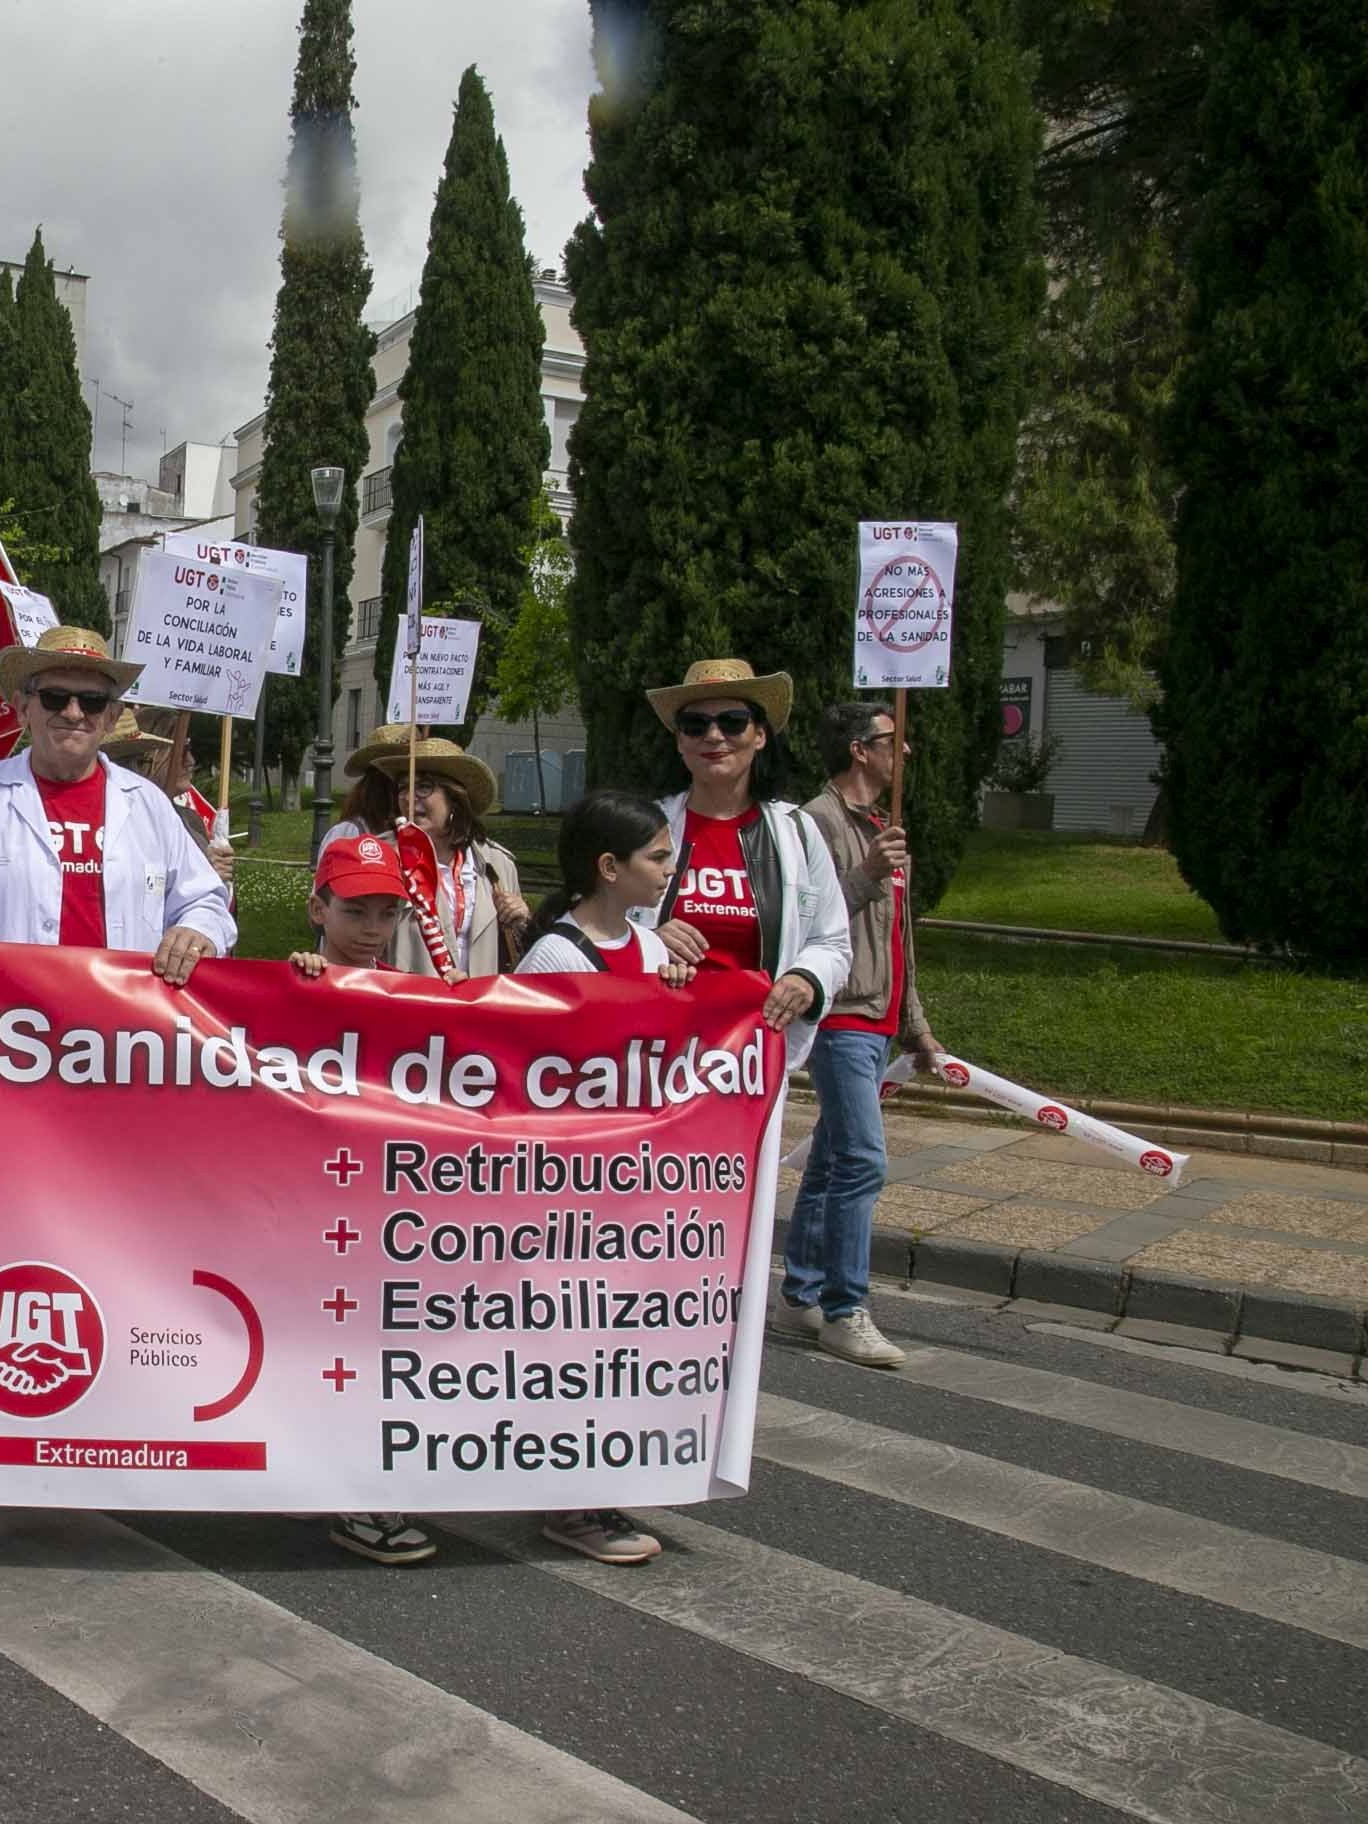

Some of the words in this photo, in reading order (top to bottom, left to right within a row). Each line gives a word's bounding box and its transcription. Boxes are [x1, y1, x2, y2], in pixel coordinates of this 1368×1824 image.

[873, 527, 901, 540] UGT
[174, 566, 205, 588] UGT
[884, 566, 903, 576] NO
[908, 563, 930, 576] MÁS
[865, 587, 934, 599] AGRESIONES
[938, 588, 946, 599] A
[186, 596, 209, 612] POR
[214, 601, 226, 616] LA
[858, 609, 949, 620] PROFESIONALES
[137, 629, 152, 644] DE
[156, 633, 171, 648] LA
[177, 637, 204, 654] VIDA
[208, 642, 253, 663] LABORAL
[857, 631, 873, 642] DE
[879, 631, 895, 642] LA
[901, 631, 948, 642] SANIDAD
[163, 657, 171, 669] Y
[175, 659, 221, 677] FAMILIAR
[48, 821, 91, 854] GT
[392, 1035, 497, 1108] de
[526, 1028, 765, 1112] calidad
[382, 1142, 746, 1196] Retribuciones
[382, 1209, 725, 1265] Conciliación
[130, 1327, 202, 1346] Servicios
[130, 1348, 198, 1367] Públicos
[380, 1342, 730, 1402] Reclasificaci
[36, 1440, 188, 1467] Extremadura
[380, 1413, 707, 1474] Profesional
